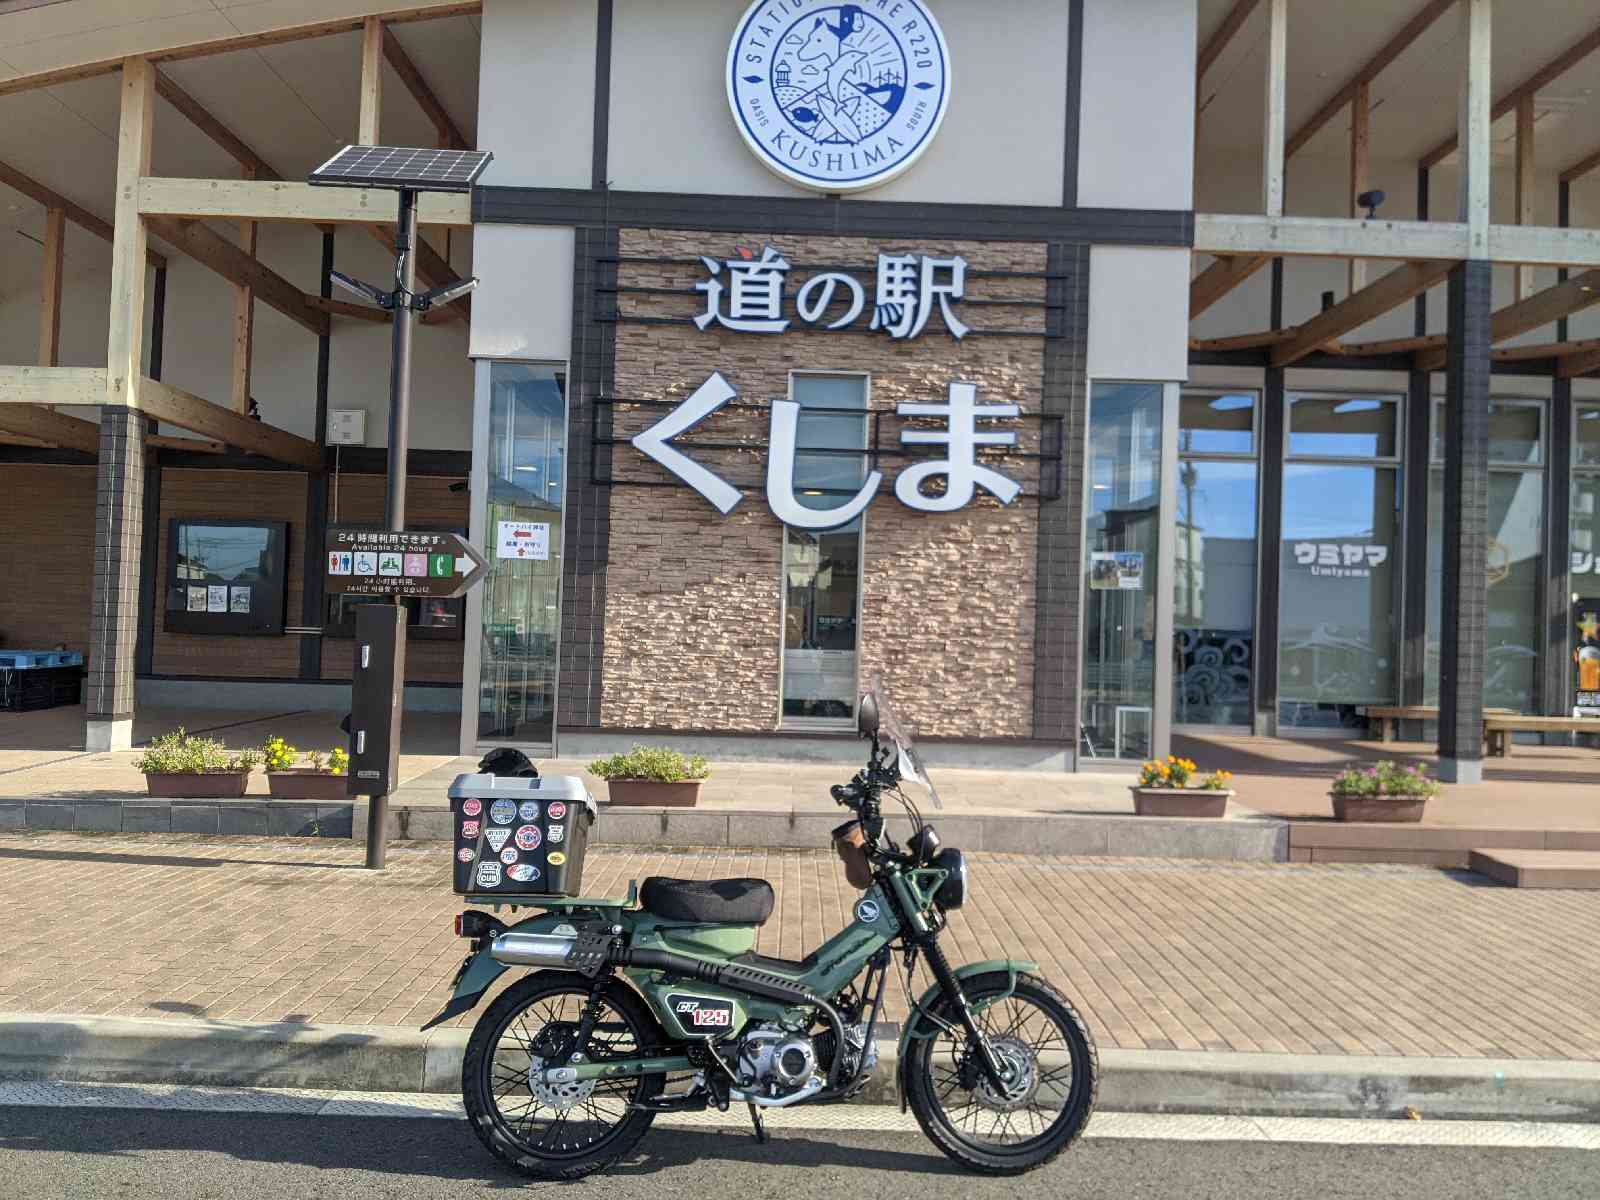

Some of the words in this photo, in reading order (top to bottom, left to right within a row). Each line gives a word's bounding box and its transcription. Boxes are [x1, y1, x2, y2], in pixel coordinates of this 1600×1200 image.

[902, 20, 933, 68] R220
[750, 98, 770, 127] OASIS
[905, 101, 928, 131] SOUTH
[771, 129, 904, 172] KUSHIMA
[692, 246, 972, 340] 道の駅
[630, 370, 1022, 529] くしま
[1294, 543, 1387, 567] ウミヤマ
[1311, 565, 1370, 578] Umiyama
[676, 1001, 699, 1012] CT
[694, 1009, 729, 1025] 125
